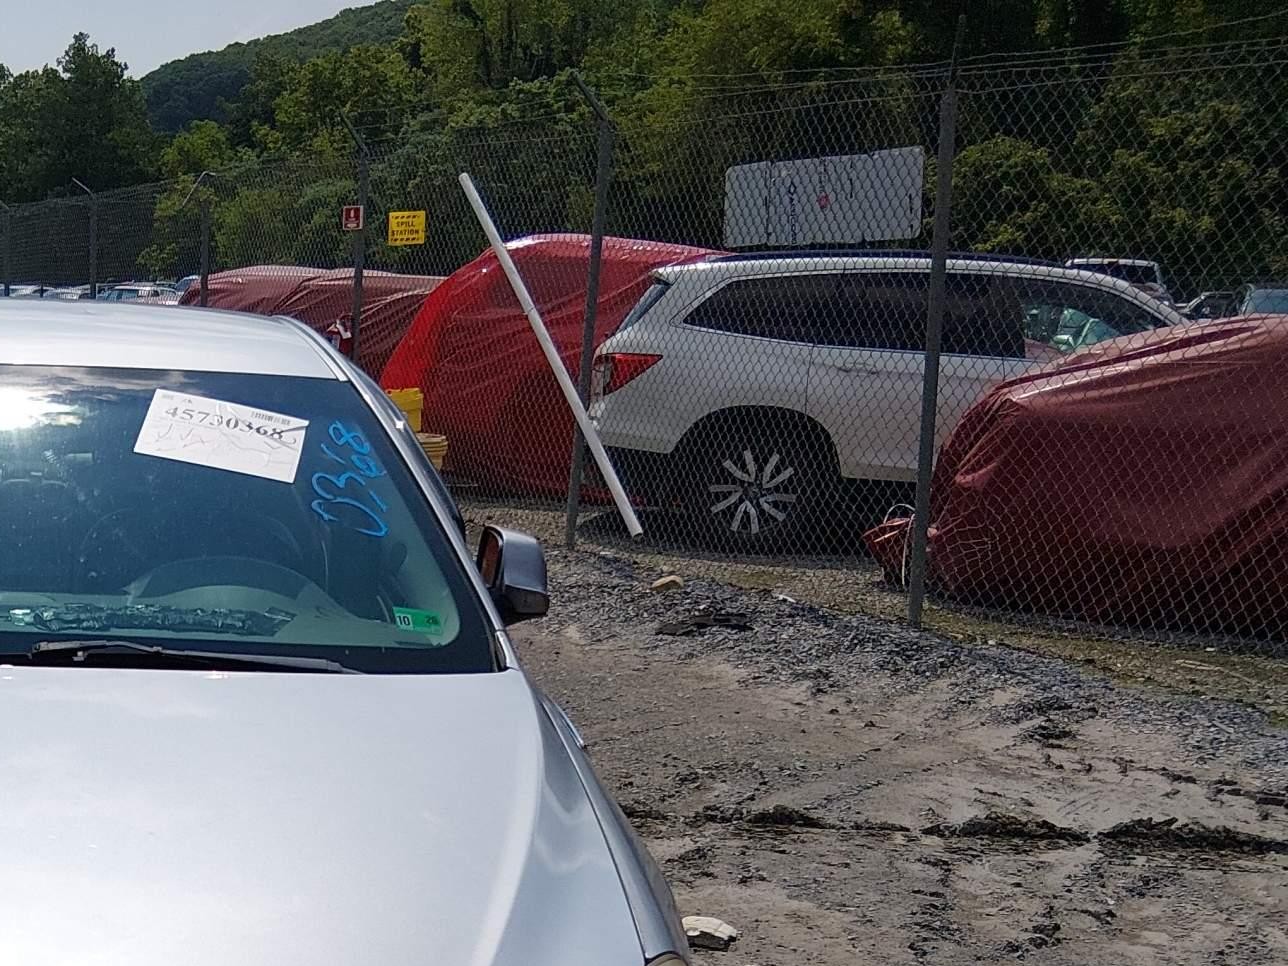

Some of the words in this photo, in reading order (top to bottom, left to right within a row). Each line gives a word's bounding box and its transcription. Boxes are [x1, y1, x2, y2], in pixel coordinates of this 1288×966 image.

[396, 220, 416, 228] SPILL
[391, 229, 419, 237] STATION
[165, 406, 284, 441] 45730368
[396, 615, 411, 626] 10
